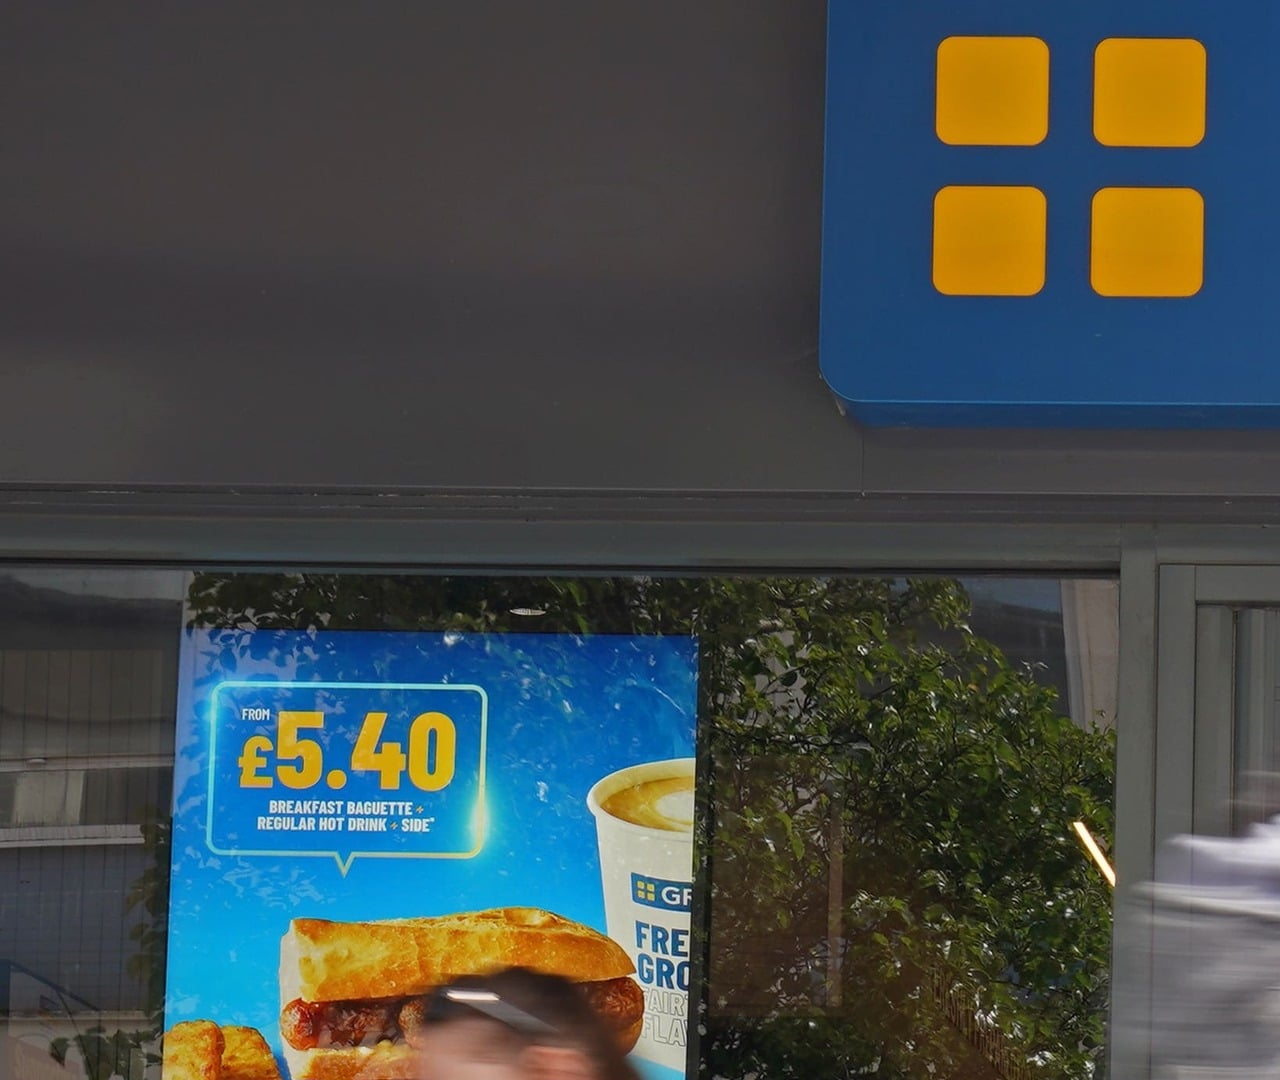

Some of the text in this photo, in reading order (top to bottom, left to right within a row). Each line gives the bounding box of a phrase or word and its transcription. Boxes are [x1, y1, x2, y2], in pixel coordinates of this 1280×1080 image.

[242, 708, 270, 721] FROM
[238, 711, 456, 792] £5.40
[269, 800, 413, 816] BREAKFAST BAGUETTE
[257, 816, 316, 831] REGULAR
[319, 817, 345, 831] HOT
[348, 817, 387, 832] DRINK
